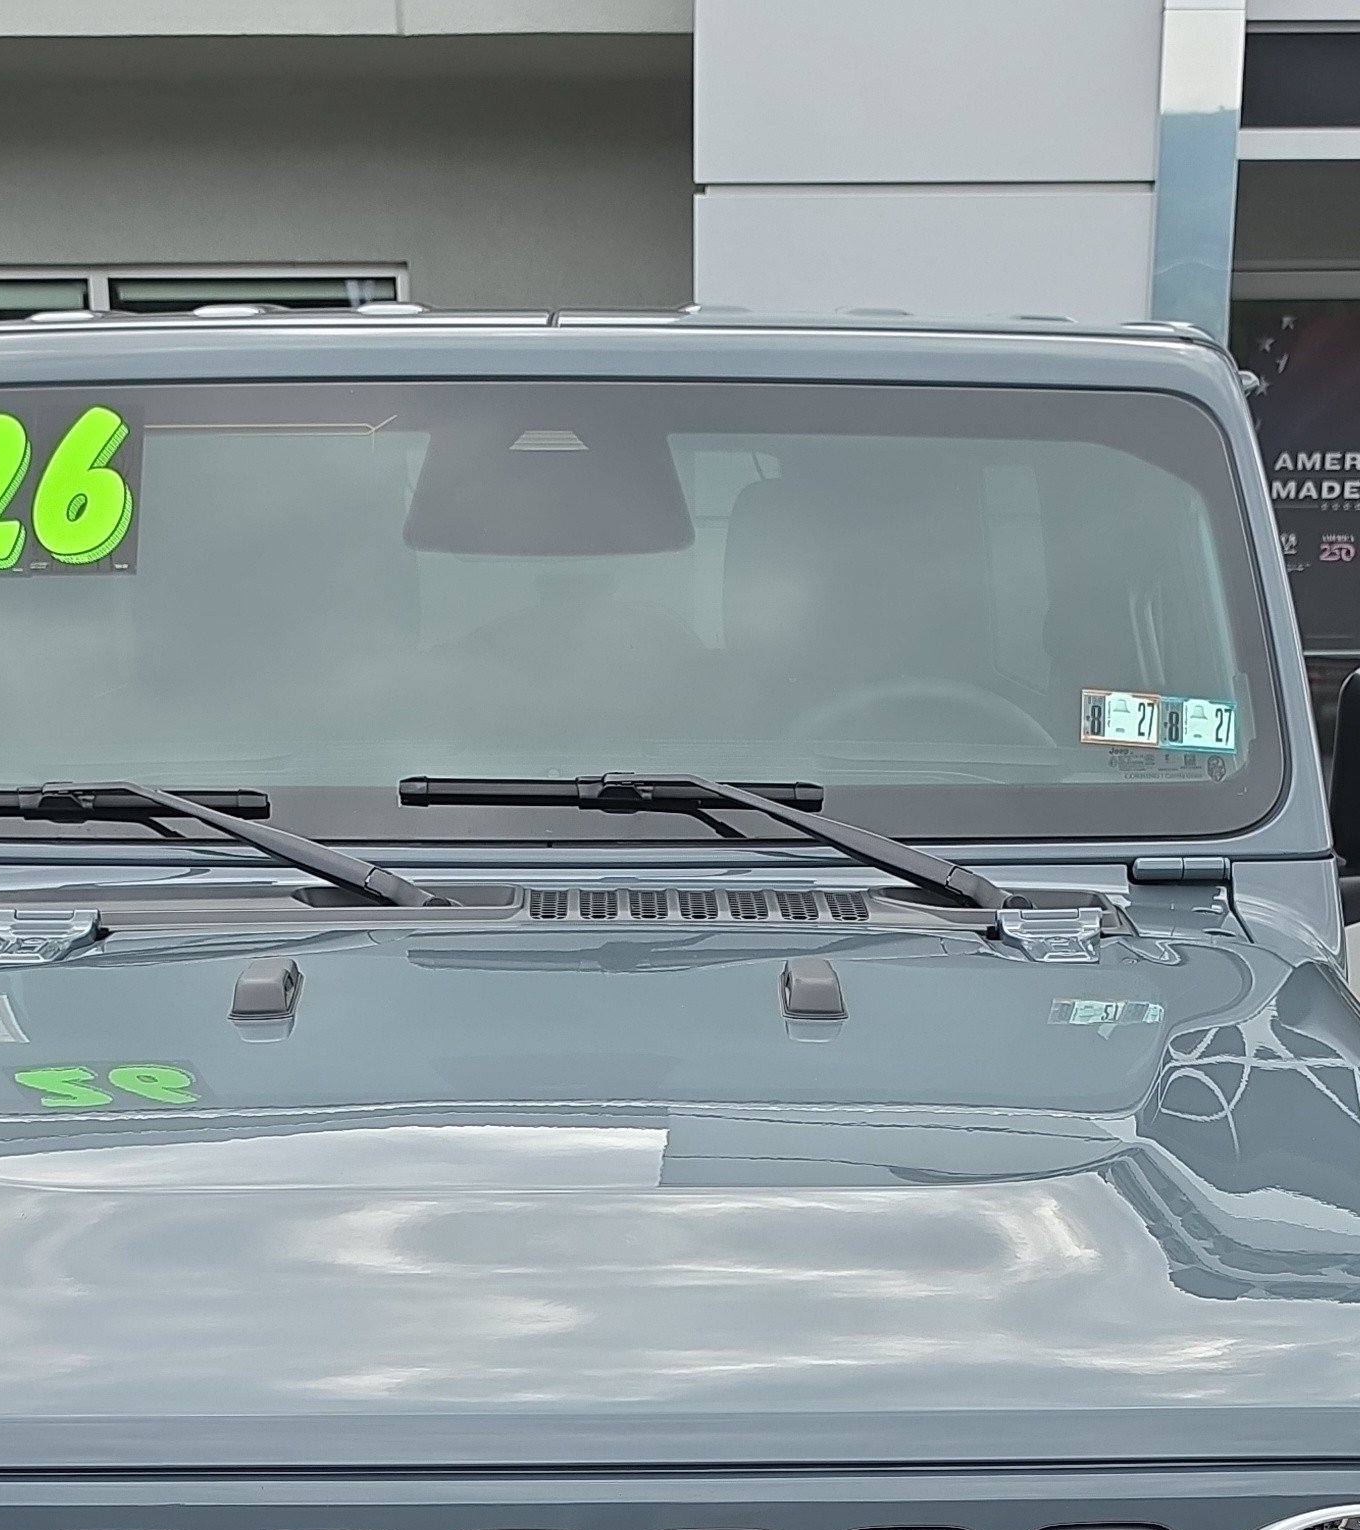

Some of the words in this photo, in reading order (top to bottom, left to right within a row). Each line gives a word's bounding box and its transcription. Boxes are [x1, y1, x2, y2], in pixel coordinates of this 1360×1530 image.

[1090, 704, 1102, 737] 8
[1137, 702, 1155, 741] 27
[1168, 711, 1180, 743] 8
[1214, 708, 1232, 746] 27
